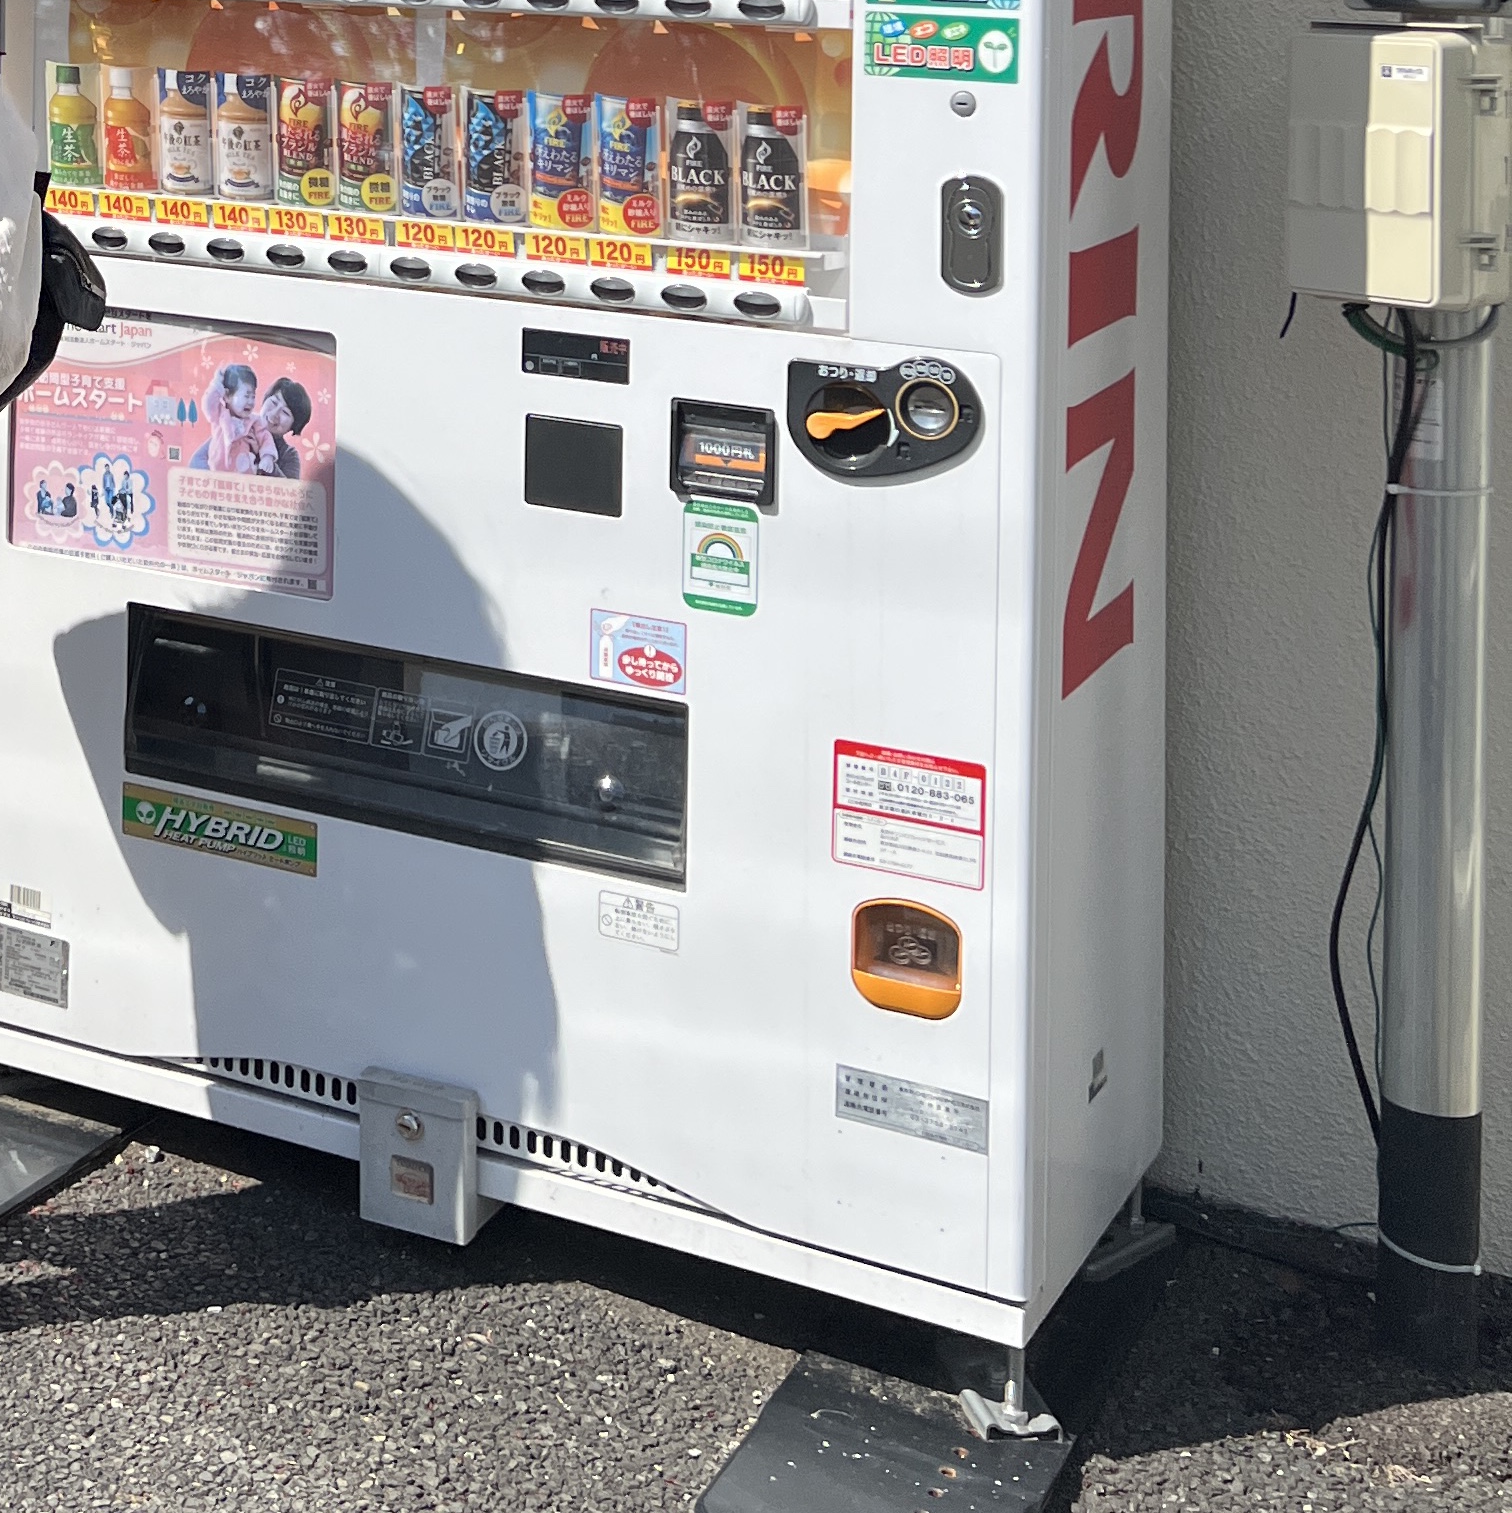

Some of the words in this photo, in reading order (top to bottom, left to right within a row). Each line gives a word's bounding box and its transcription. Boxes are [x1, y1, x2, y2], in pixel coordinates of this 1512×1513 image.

[873, 42, 975, 71] LED照明
[185, 74, 207, 83] コク
[245, 78, 266, 87] コク
[288, 119, 309, 128] FIRE
[349, 122, 369, 131] FIRE
[61, 127, 80, 162] 生茶
[116, 128, 132, 157] 生茶
[537, 159, 574, 173] キリマン
[603, 163, 639, 178] キリマン
[671, 165, 726, 185] BLACK
[426, 186, 451, 195] ブラック
[742, 170, 797, 191] BLACK
[50, 189, 89, 210] 140円
[105, 194, 144, 215] 140円
[308, 191, 330, 200] FIRE
[369, 196, 391, 205] FIRE
[495, 191, 521, 200] ブラック
[567, 194, 587, 202] ミルク
[631, 199, 652, 208] ミルク
[161, 200, 202, 221] 140円
[219, 205, 261, 227] 140円
[276, 210, 318, 232] 130円
[565, 214, 589, 224] FIRE
[335, 216, 379, 238] 130円
[403, 222, 447, 244] 120円
[630, 218, 655, 229] FIRE
[463, 228, 507, 251] 120円
[533, 235, 580, 258] 120円
[596, 241, 645, 264] 120円
[676, 248, 724, 271] 150円
[748, 255, 797, 279] 150円
[119, 322, 153, 339] Japan
[16, 385, 143, 413] ホームスタート
[698, 441, 756, 460] 1000円札
[621, 654, 679, 673] 少し待ってから
[897, 783, 975, 805] 0120-883-065
[153, 805, 284, 851] HYBRID
[162, 828, 199, 845] HEAT
[198, 837, 236, 854] PUMP
[288, 835, 307, 847] LED
